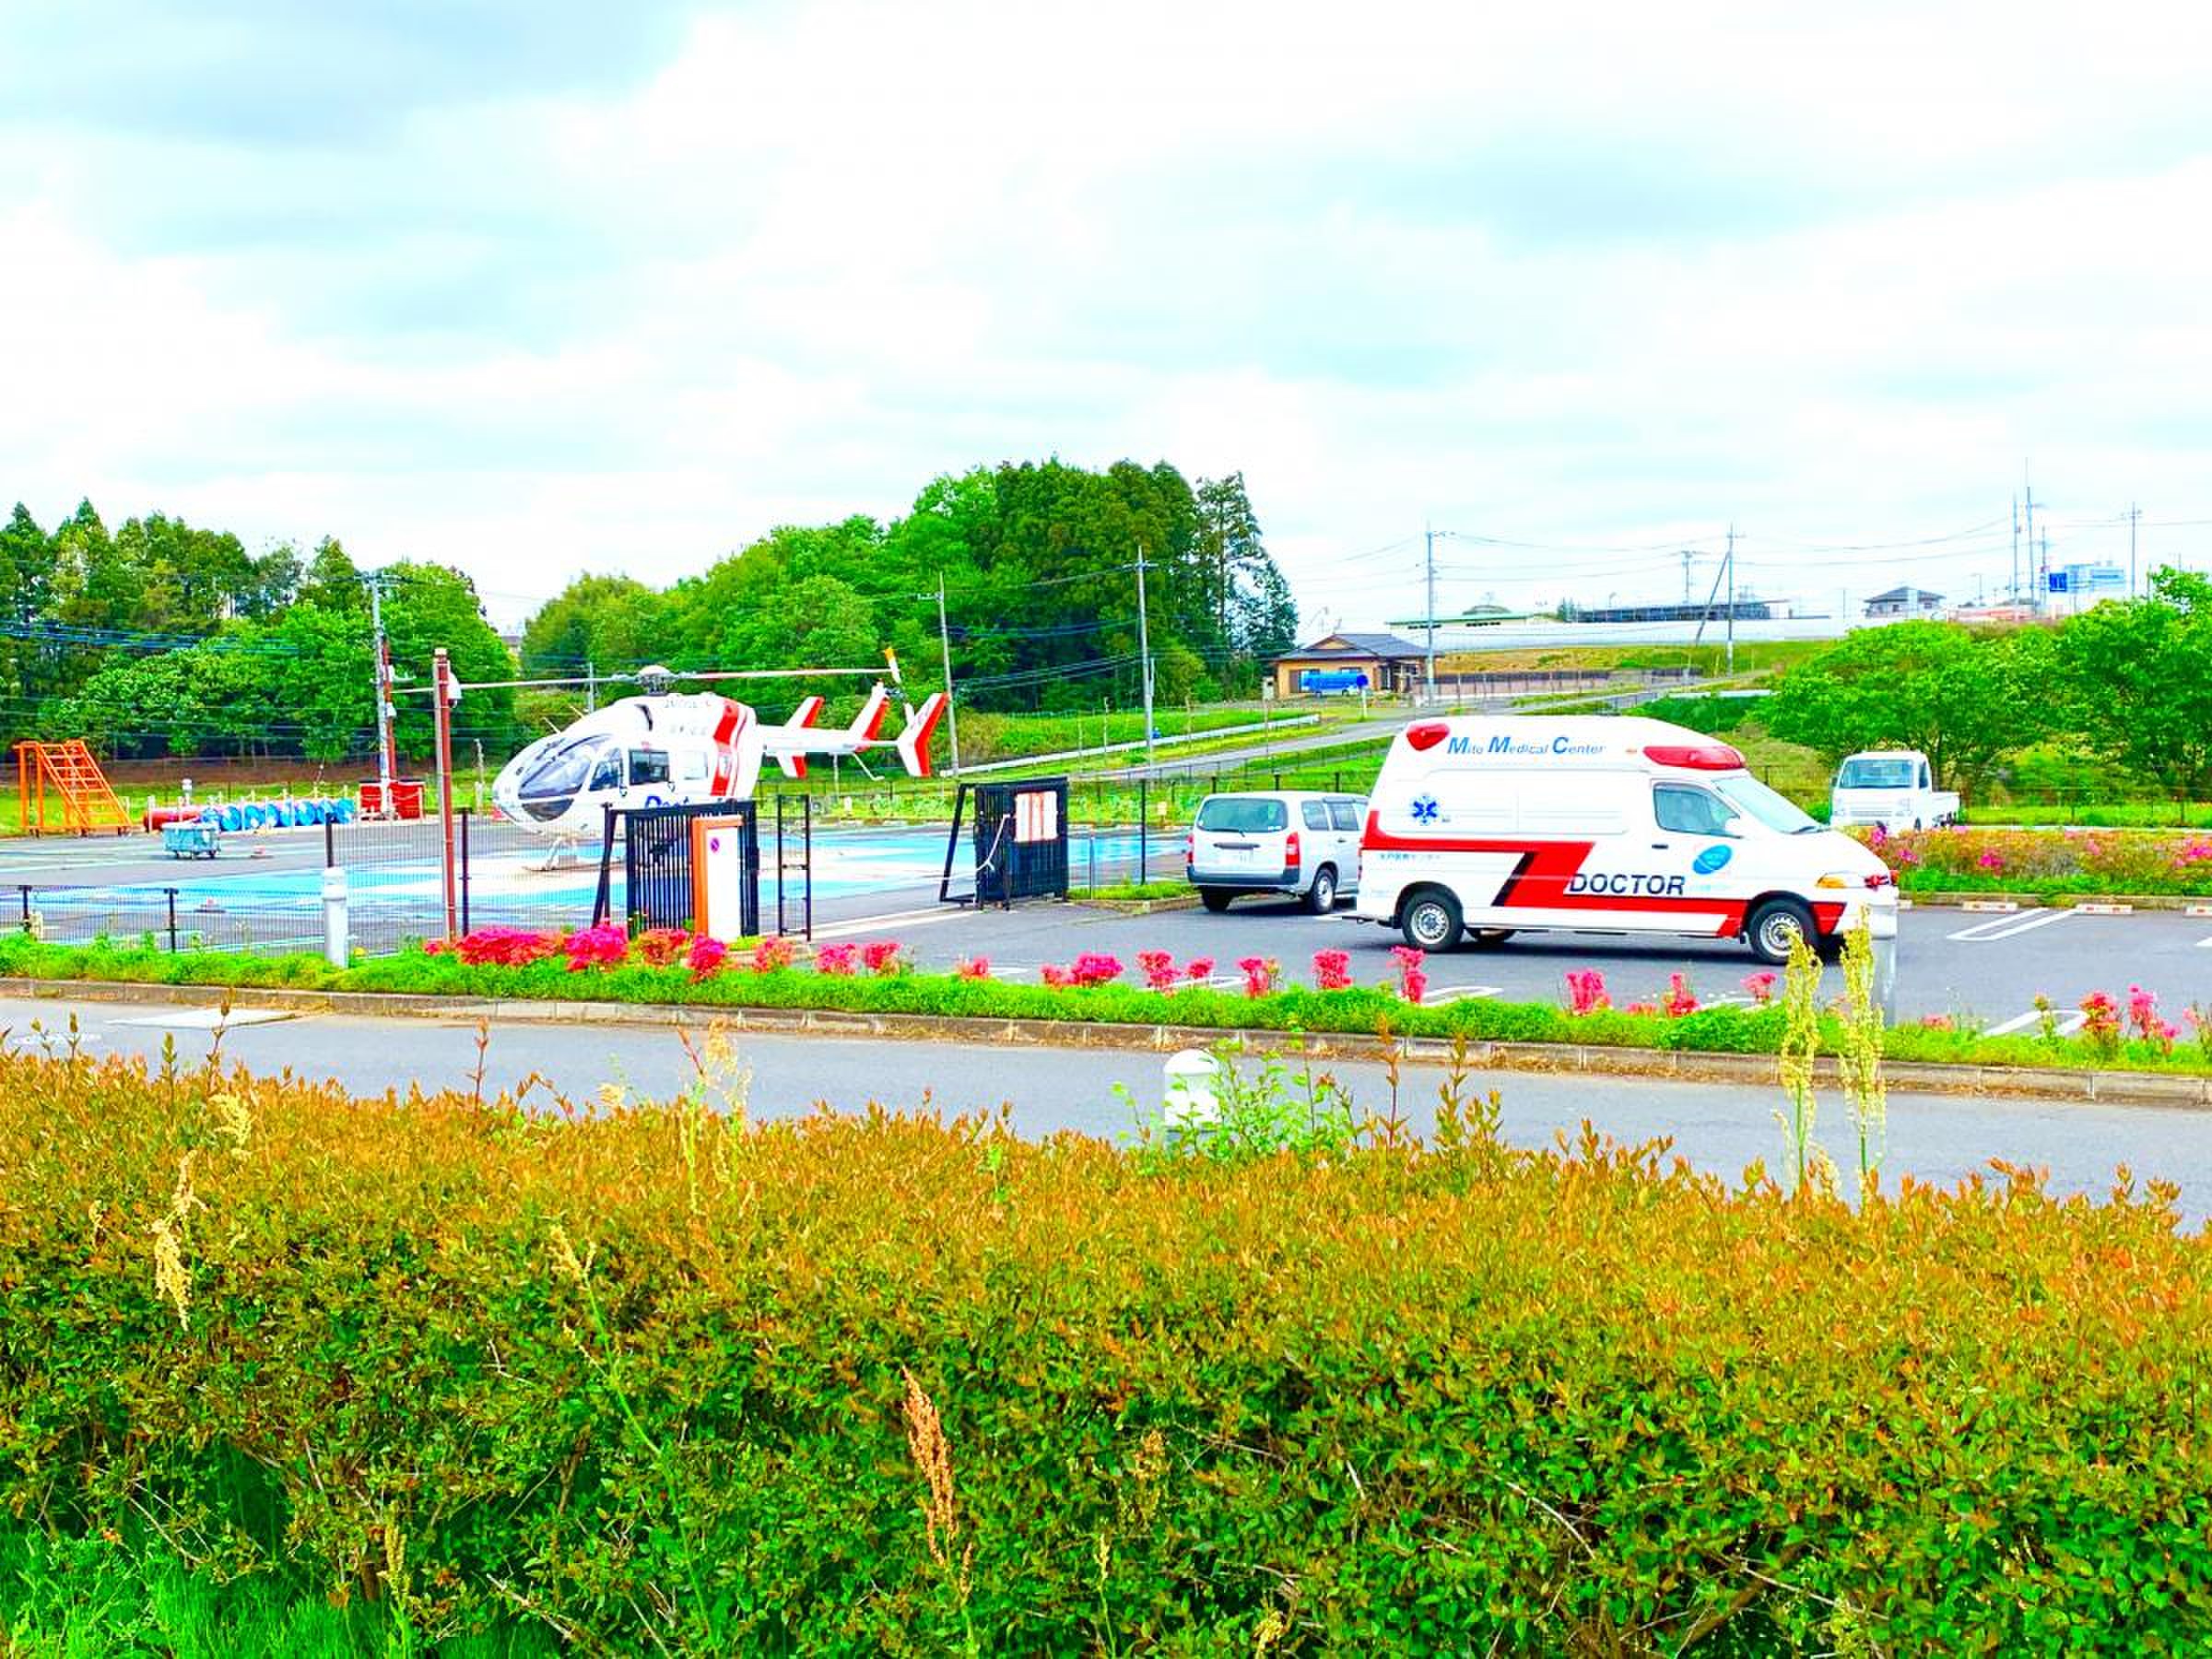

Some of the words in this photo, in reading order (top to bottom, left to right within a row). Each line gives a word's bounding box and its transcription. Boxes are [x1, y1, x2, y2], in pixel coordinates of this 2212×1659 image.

[1447, 736, 1484, 755] Mito
[1488, 735, 1548, 754] Medical
[1551, 735, 1606, 755] Center
[1569, 874, 1686, 896] DOCTOR
